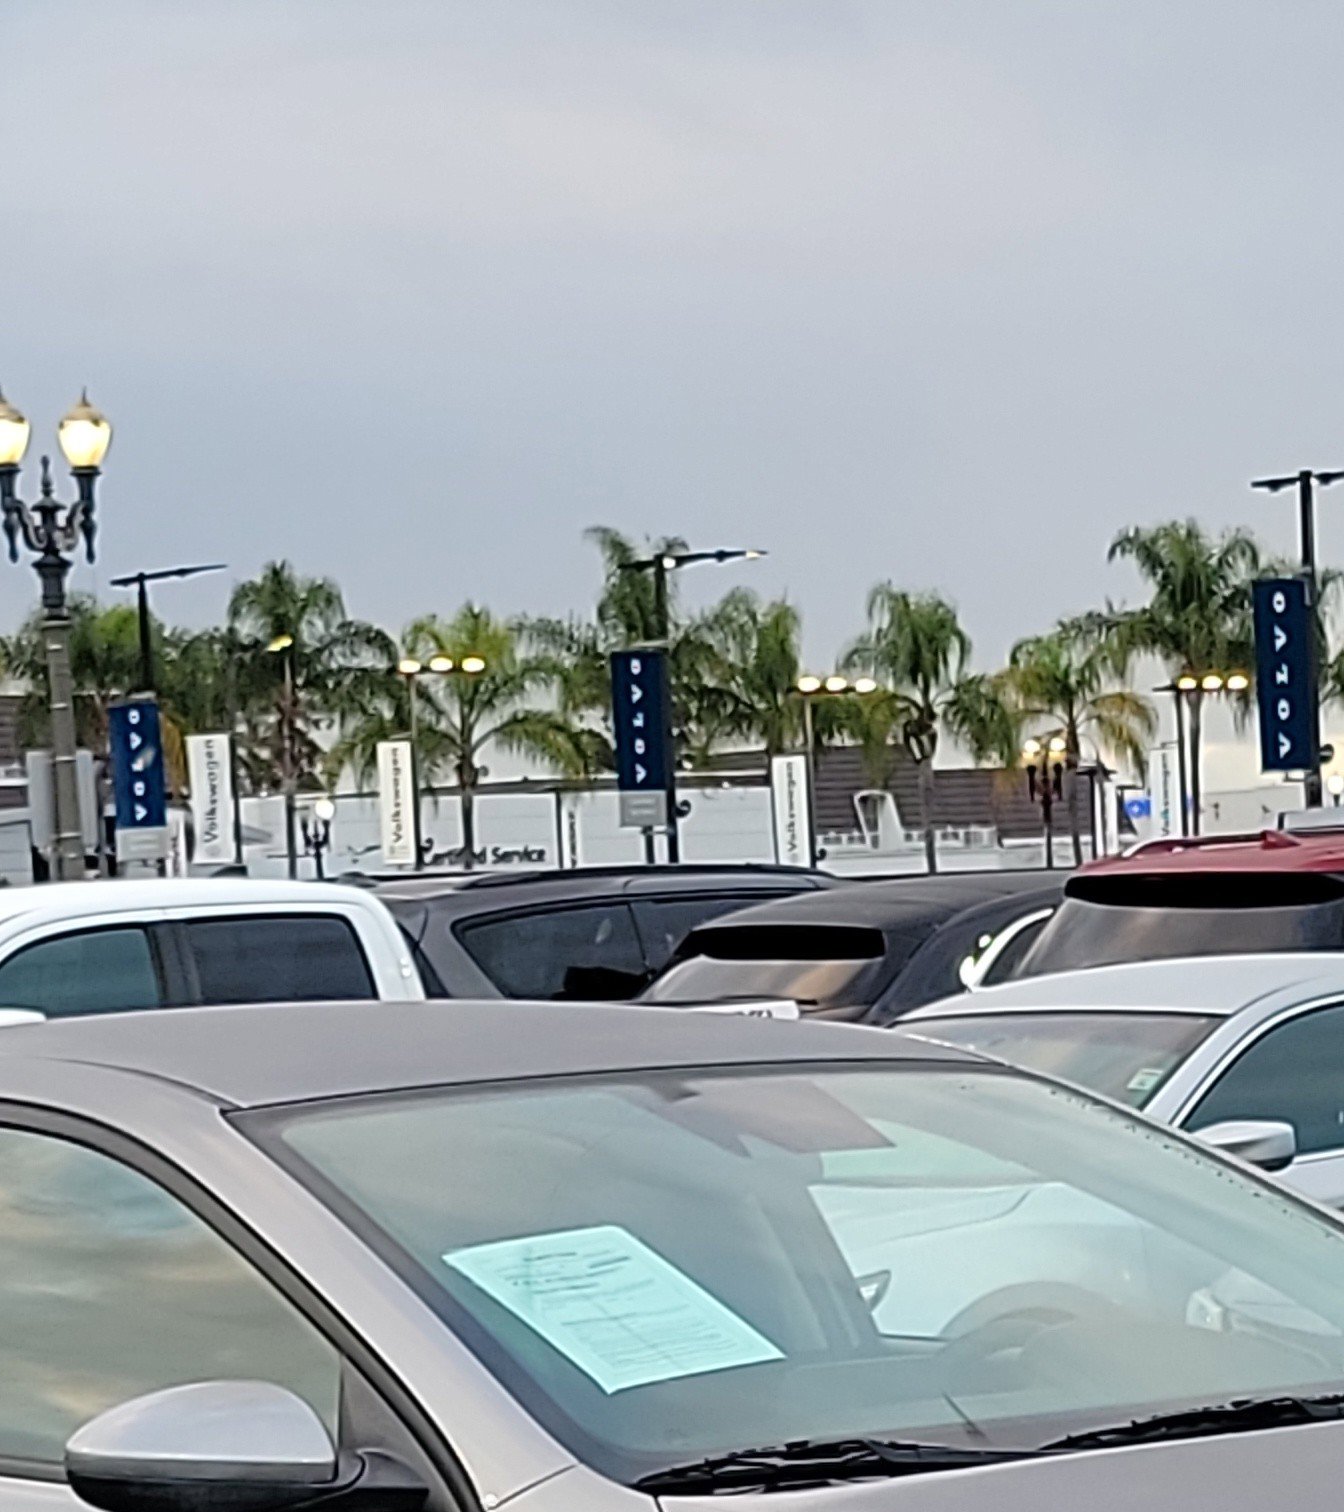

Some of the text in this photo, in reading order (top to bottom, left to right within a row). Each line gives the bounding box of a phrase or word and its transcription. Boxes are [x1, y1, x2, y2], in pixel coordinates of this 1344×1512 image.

[630, 658, 647, 783] VOLVO
[1272, 590, 1292, 760] VOLVO
[204, 739, 219, 843] Volkswagen
[491, 845, 546, 864] Service
